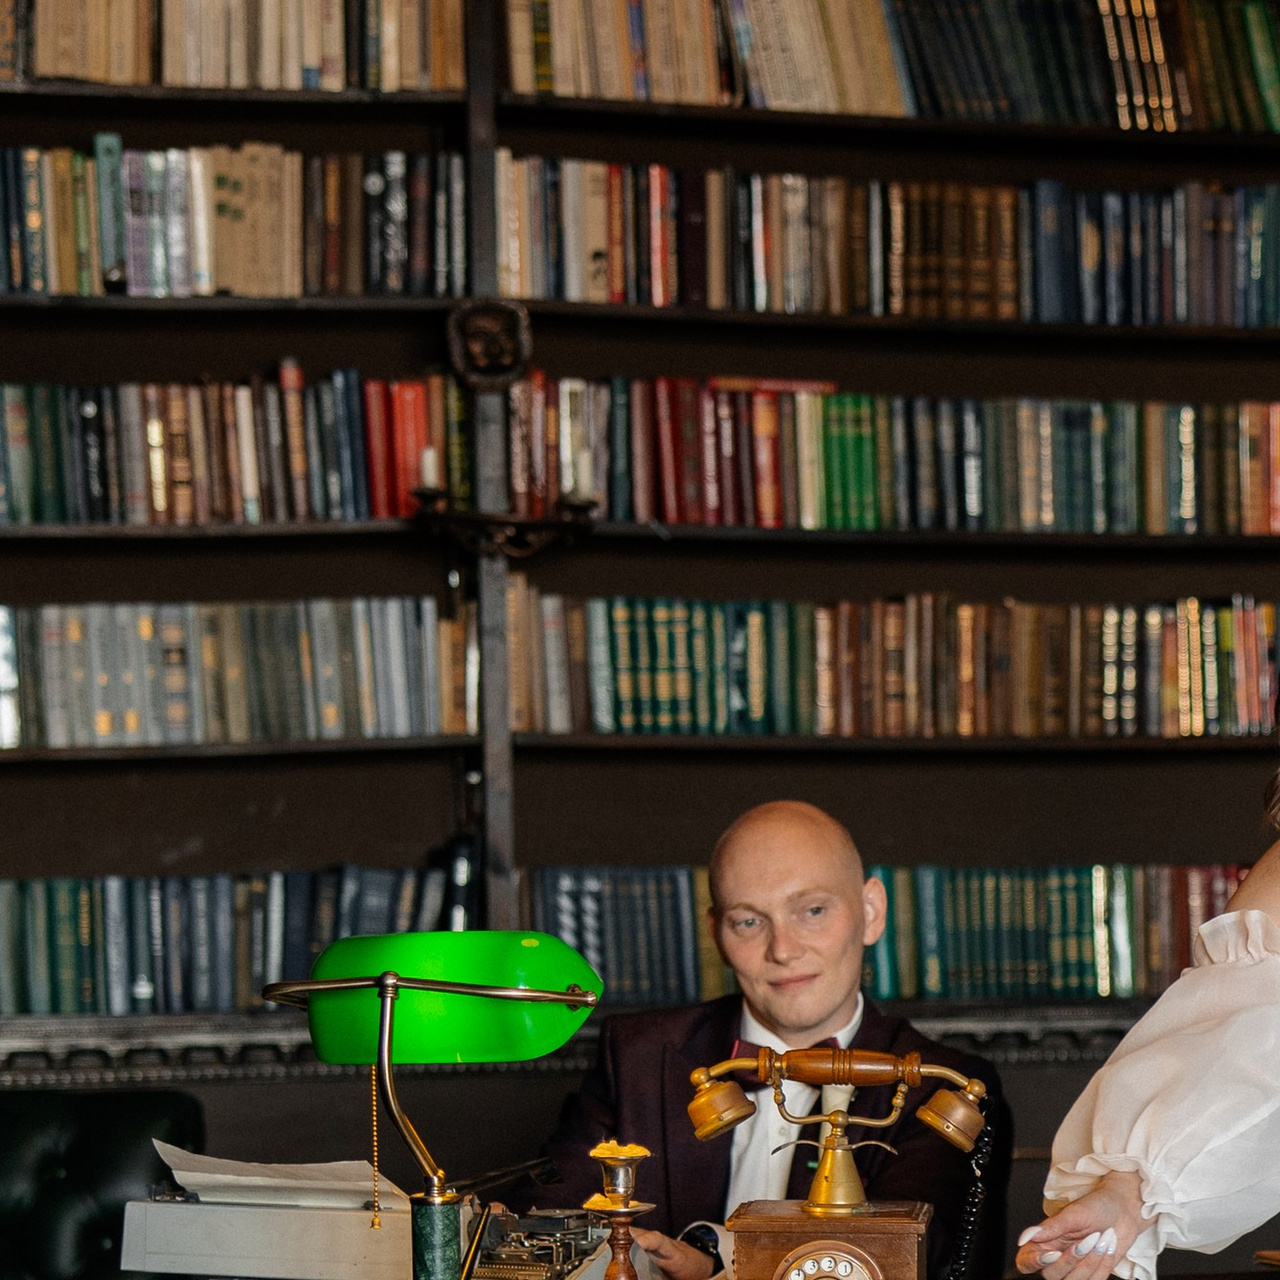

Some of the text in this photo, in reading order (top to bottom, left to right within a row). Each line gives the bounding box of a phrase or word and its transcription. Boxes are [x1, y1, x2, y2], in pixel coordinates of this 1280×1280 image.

[810, 1261, 816, 1270] 3
[828, 1260, 833, 1269] 2
[844, 1264, 848, 1273] 1
[795, 1268, 801, 1277] 4
